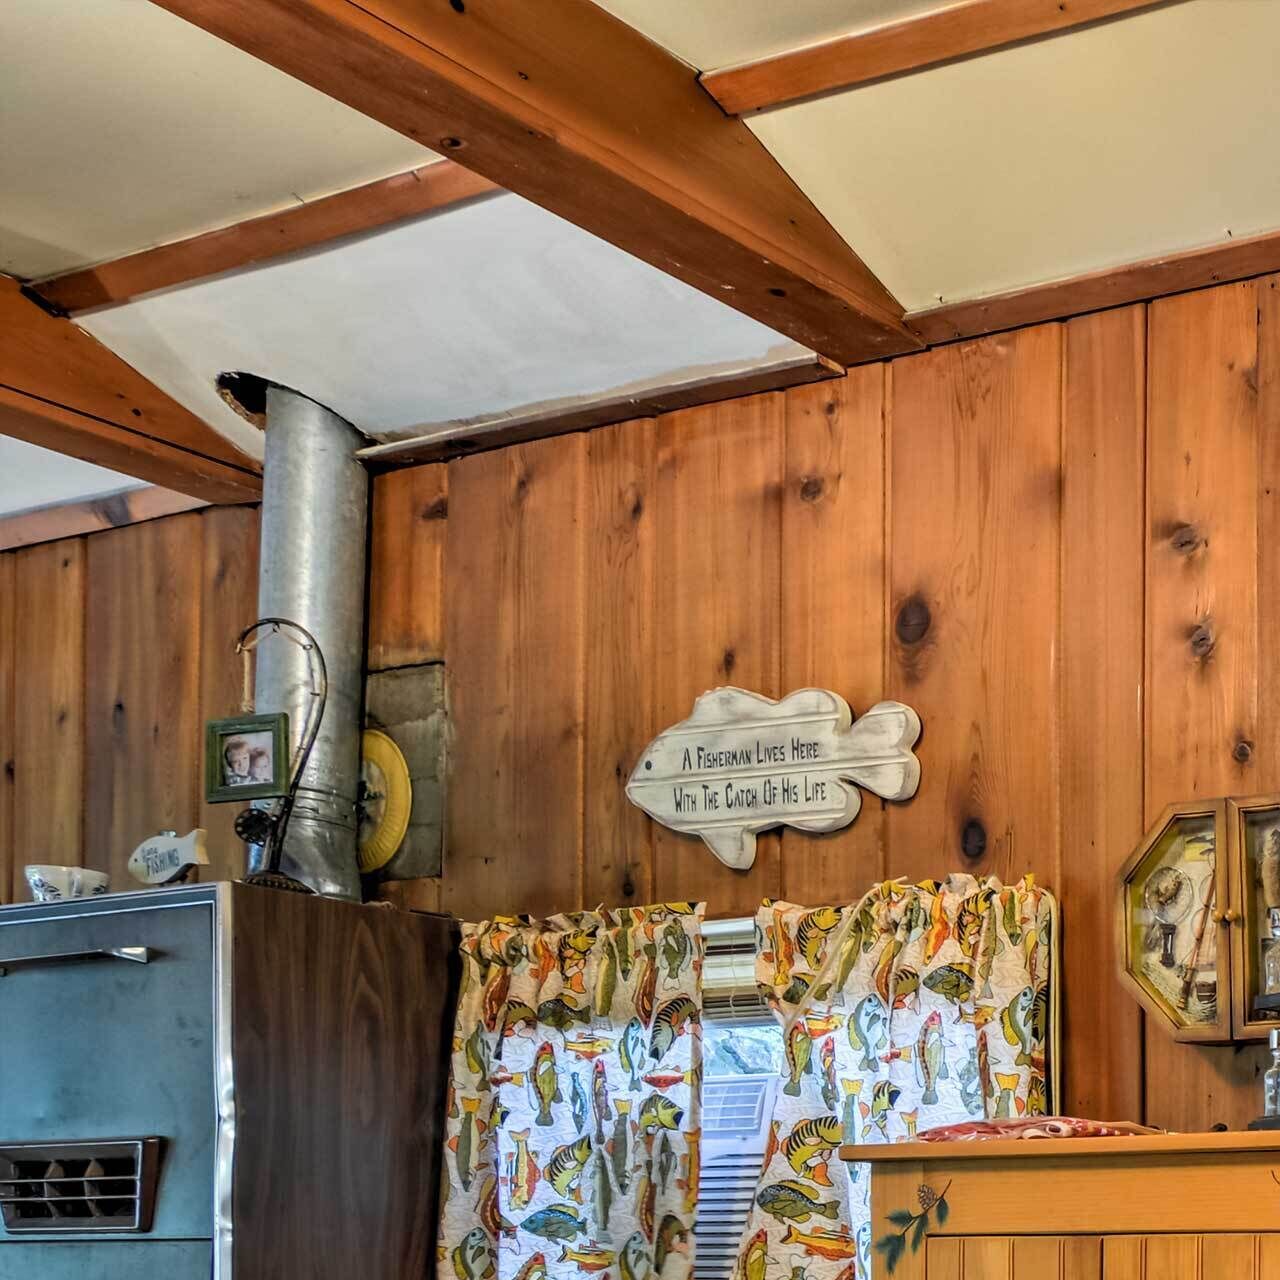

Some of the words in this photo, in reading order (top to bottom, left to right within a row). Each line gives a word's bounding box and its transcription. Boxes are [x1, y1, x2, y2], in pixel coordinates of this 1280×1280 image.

[682, 748, 692, 770] A
[697, 746, 752, 769] FISHERMAN
[756, 740, 785, 764] LIVES
[791, 737, 819, 761] HERE
[673, 787, 697, 813] WITH
[702, 784, 719, 811] THE
[725, 782, 757, 809] CATCH
[763, 778, 778, 806] OF
[781, 777, 799, 805] HIS
[804, 775, 827, 802] LIFE
